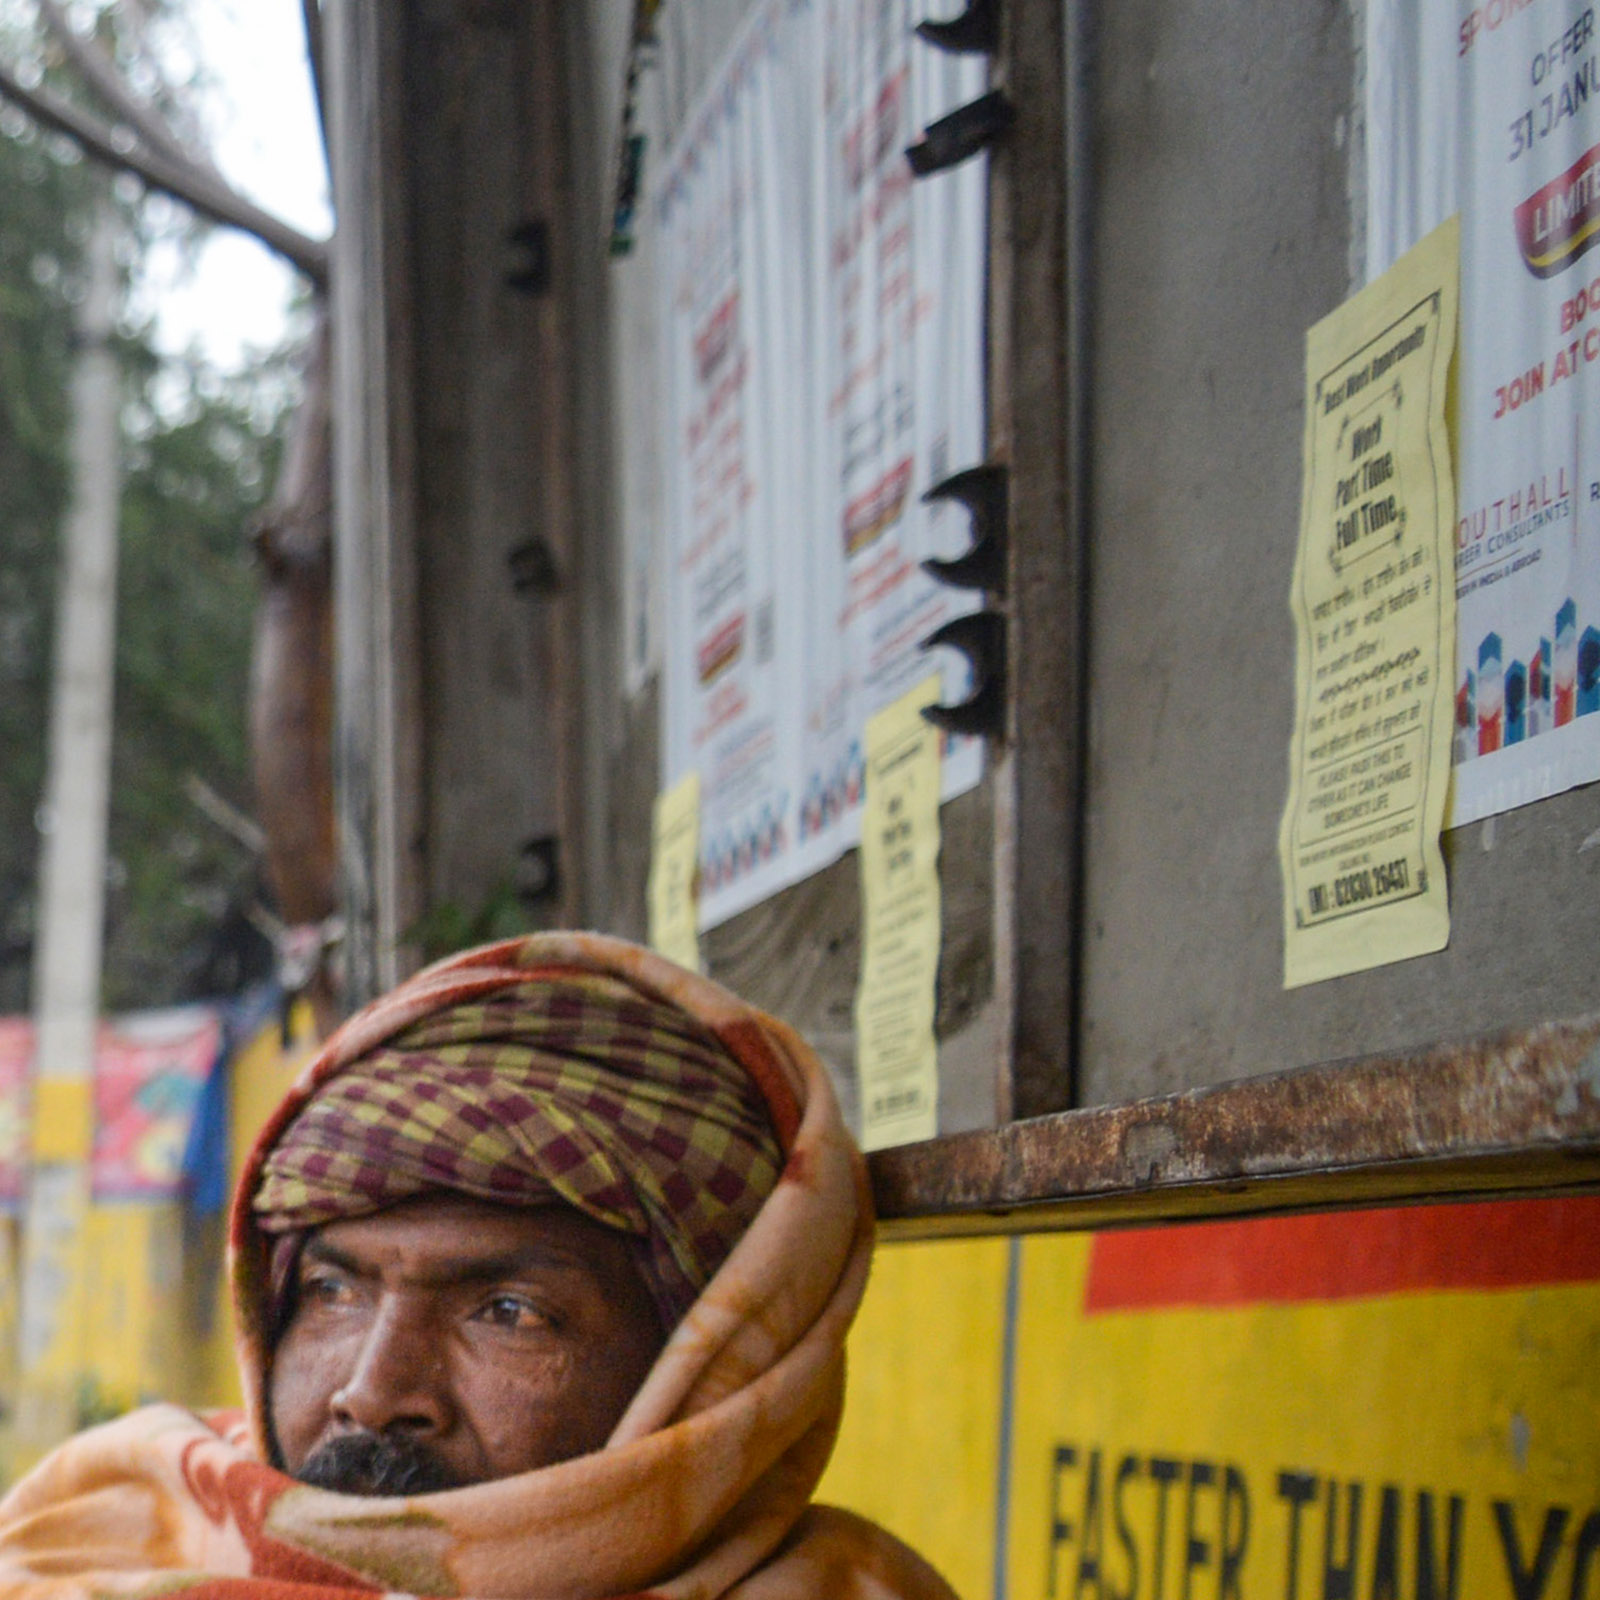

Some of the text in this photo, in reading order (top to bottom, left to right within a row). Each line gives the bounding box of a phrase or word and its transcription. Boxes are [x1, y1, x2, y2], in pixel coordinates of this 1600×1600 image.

[1531, 7, 1593, 86] OFFER
[1508, 109, 1533, 162] 31
[1494, 362, 1544, 420] JOIN
[1549, 339, 1580, 387] AT
[1335, 451, 1394, 511] Part Time
[1457, 467, 1569, 548] OUTHALL
[1361, 494, 1397, 535] Time
[1487, 499, 1569, 554] CONSULTANTS
